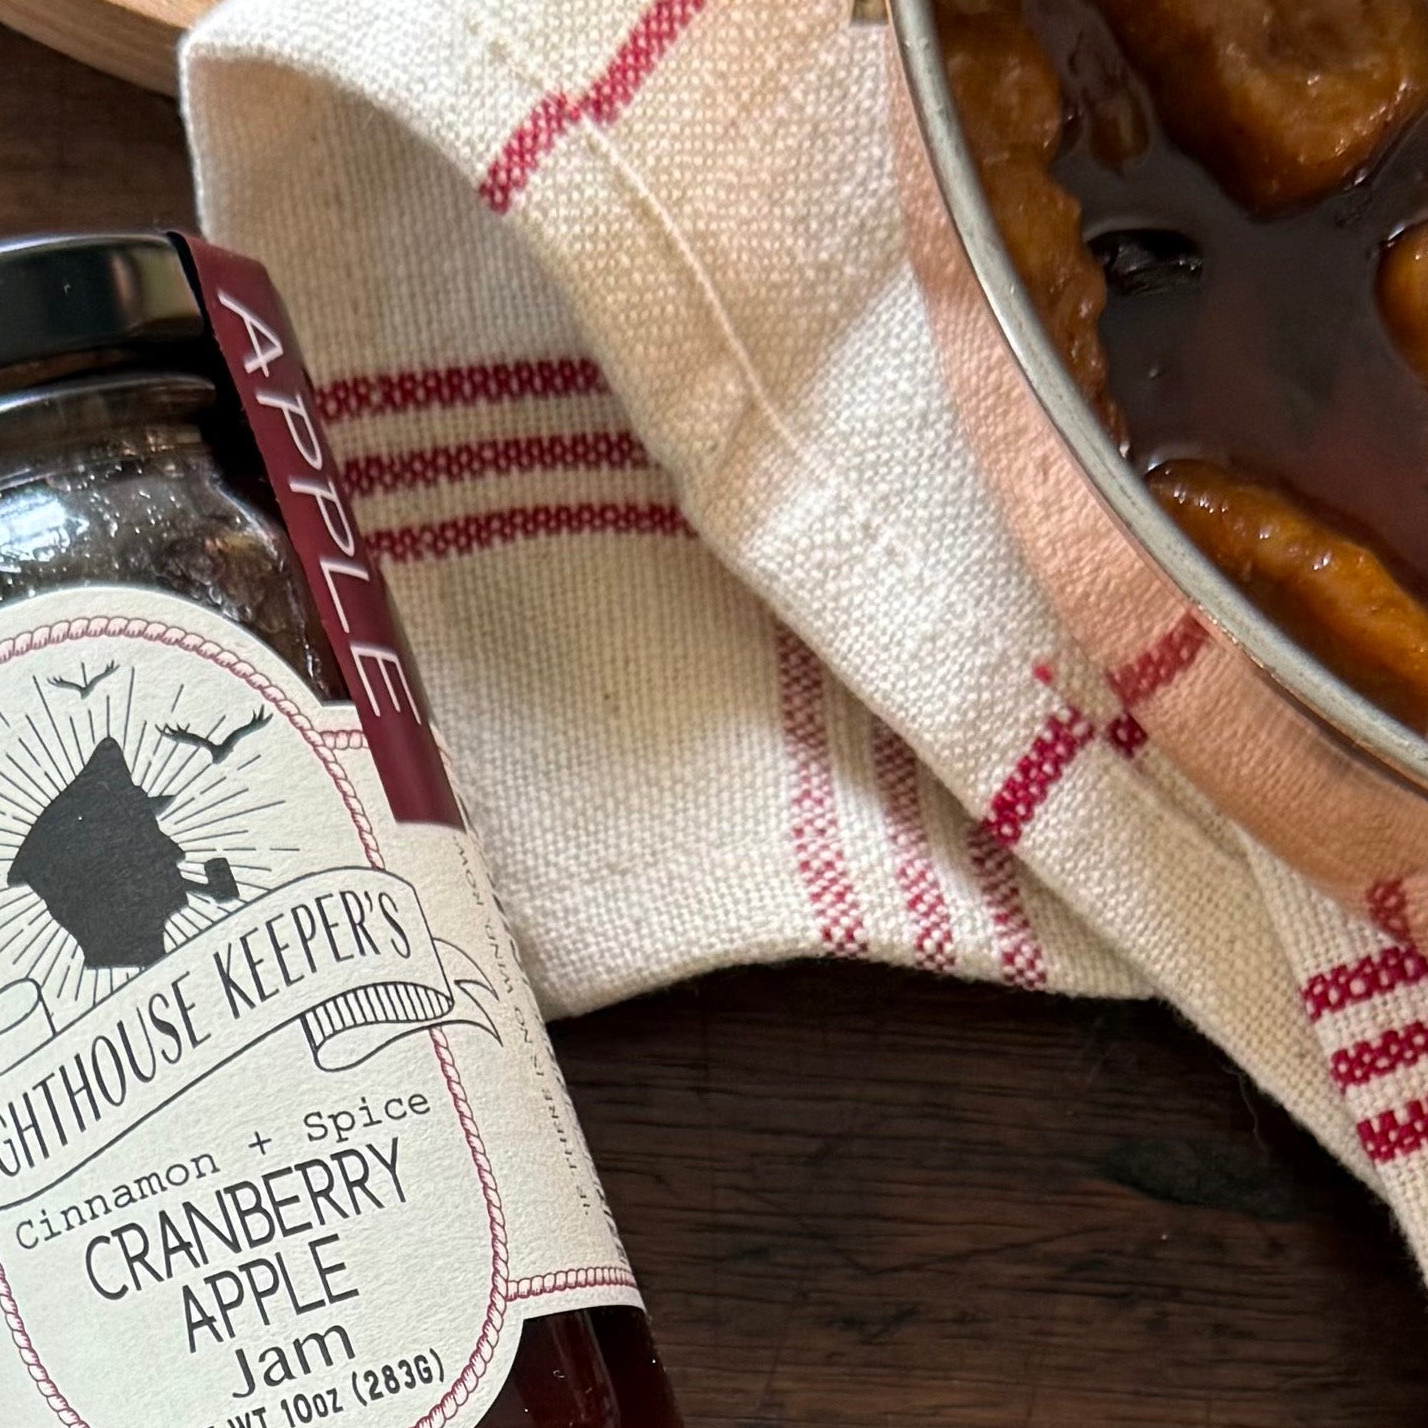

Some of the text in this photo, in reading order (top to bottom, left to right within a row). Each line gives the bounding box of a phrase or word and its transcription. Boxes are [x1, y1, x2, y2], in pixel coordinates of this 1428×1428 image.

[217, 290, 423, 726] APPLE
[213, 890, 412, 1020] KEEPER'S
[15, 1093, 432, 1251] Cinnamon + Spice
[84, 1136, 407, 1301] CRANBERRY
[182, 1233, 360, 1353] APPLE
[232, 1324, 357, 1399] Jam
[351, 1348, 446, 1406] (283G)
